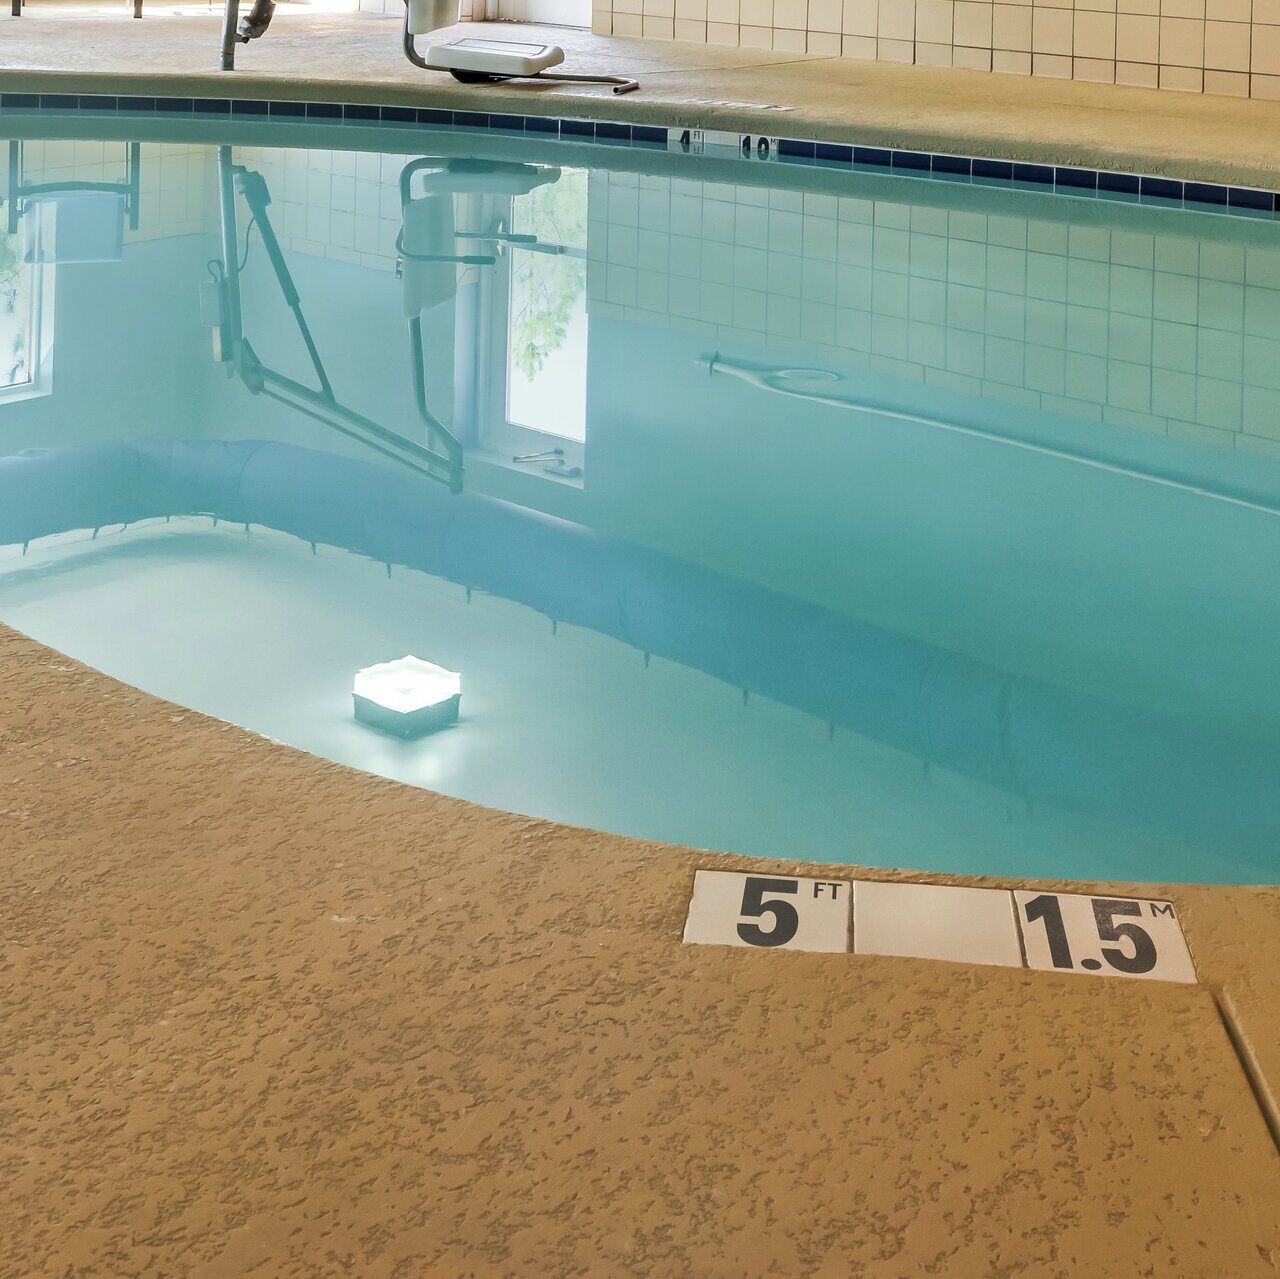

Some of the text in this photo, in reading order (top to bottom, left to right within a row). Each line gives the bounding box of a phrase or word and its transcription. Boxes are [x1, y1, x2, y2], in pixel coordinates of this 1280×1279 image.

[736, 876, 1176, 976] 5 FT 1.5 M
